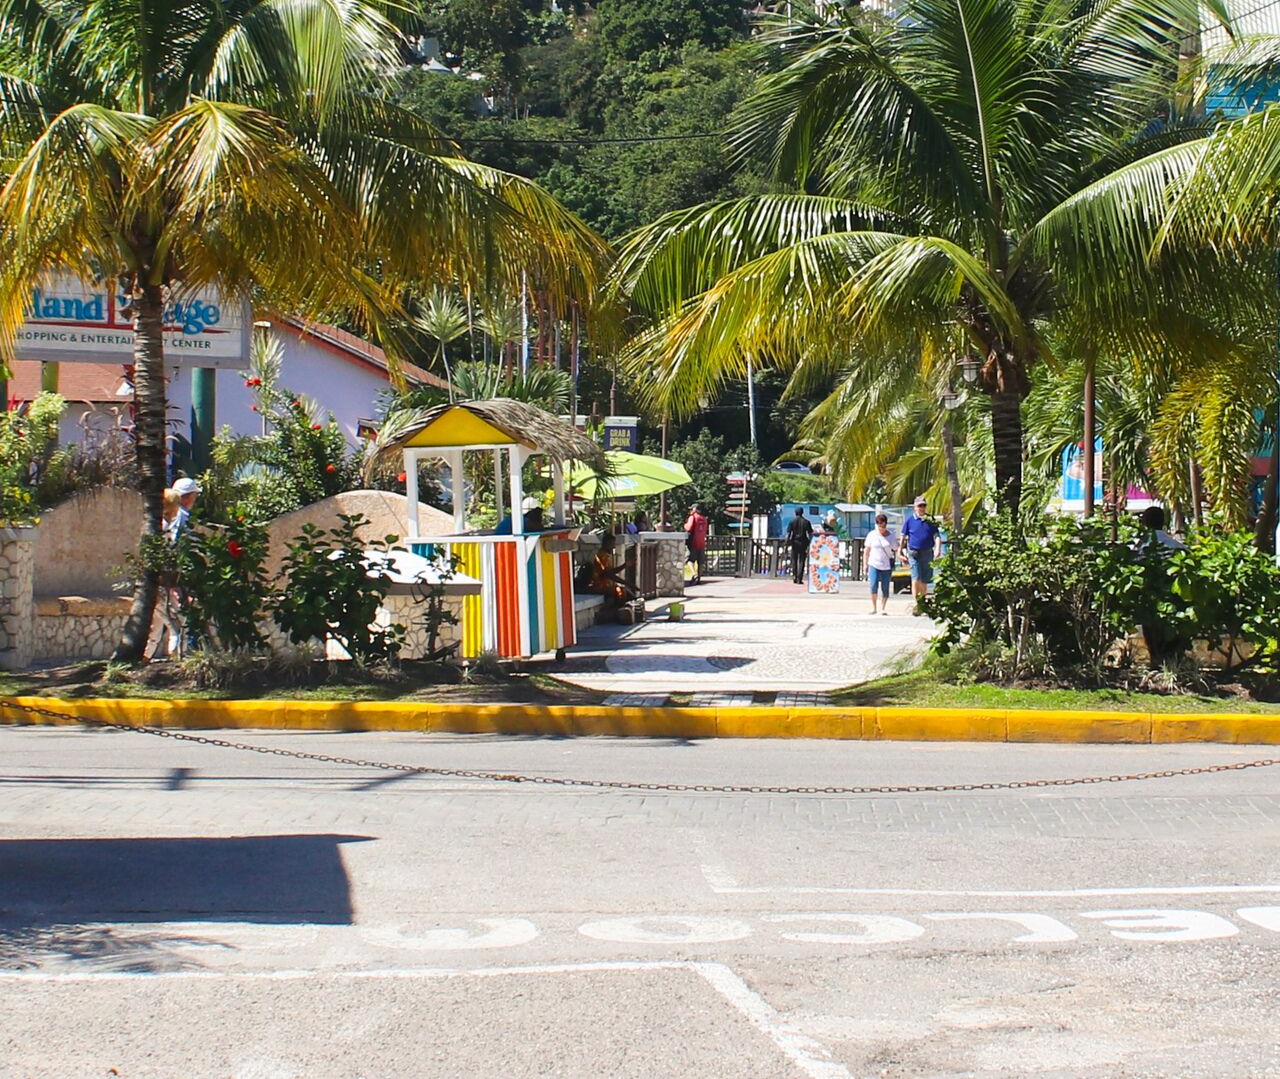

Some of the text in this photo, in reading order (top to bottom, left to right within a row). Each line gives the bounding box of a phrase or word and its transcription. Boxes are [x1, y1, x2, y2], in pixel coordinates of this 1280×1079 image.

[23, 287, 104, 321] land
[13, 331, 212, 349] HOPPING & ENTERTAIT CENTER
